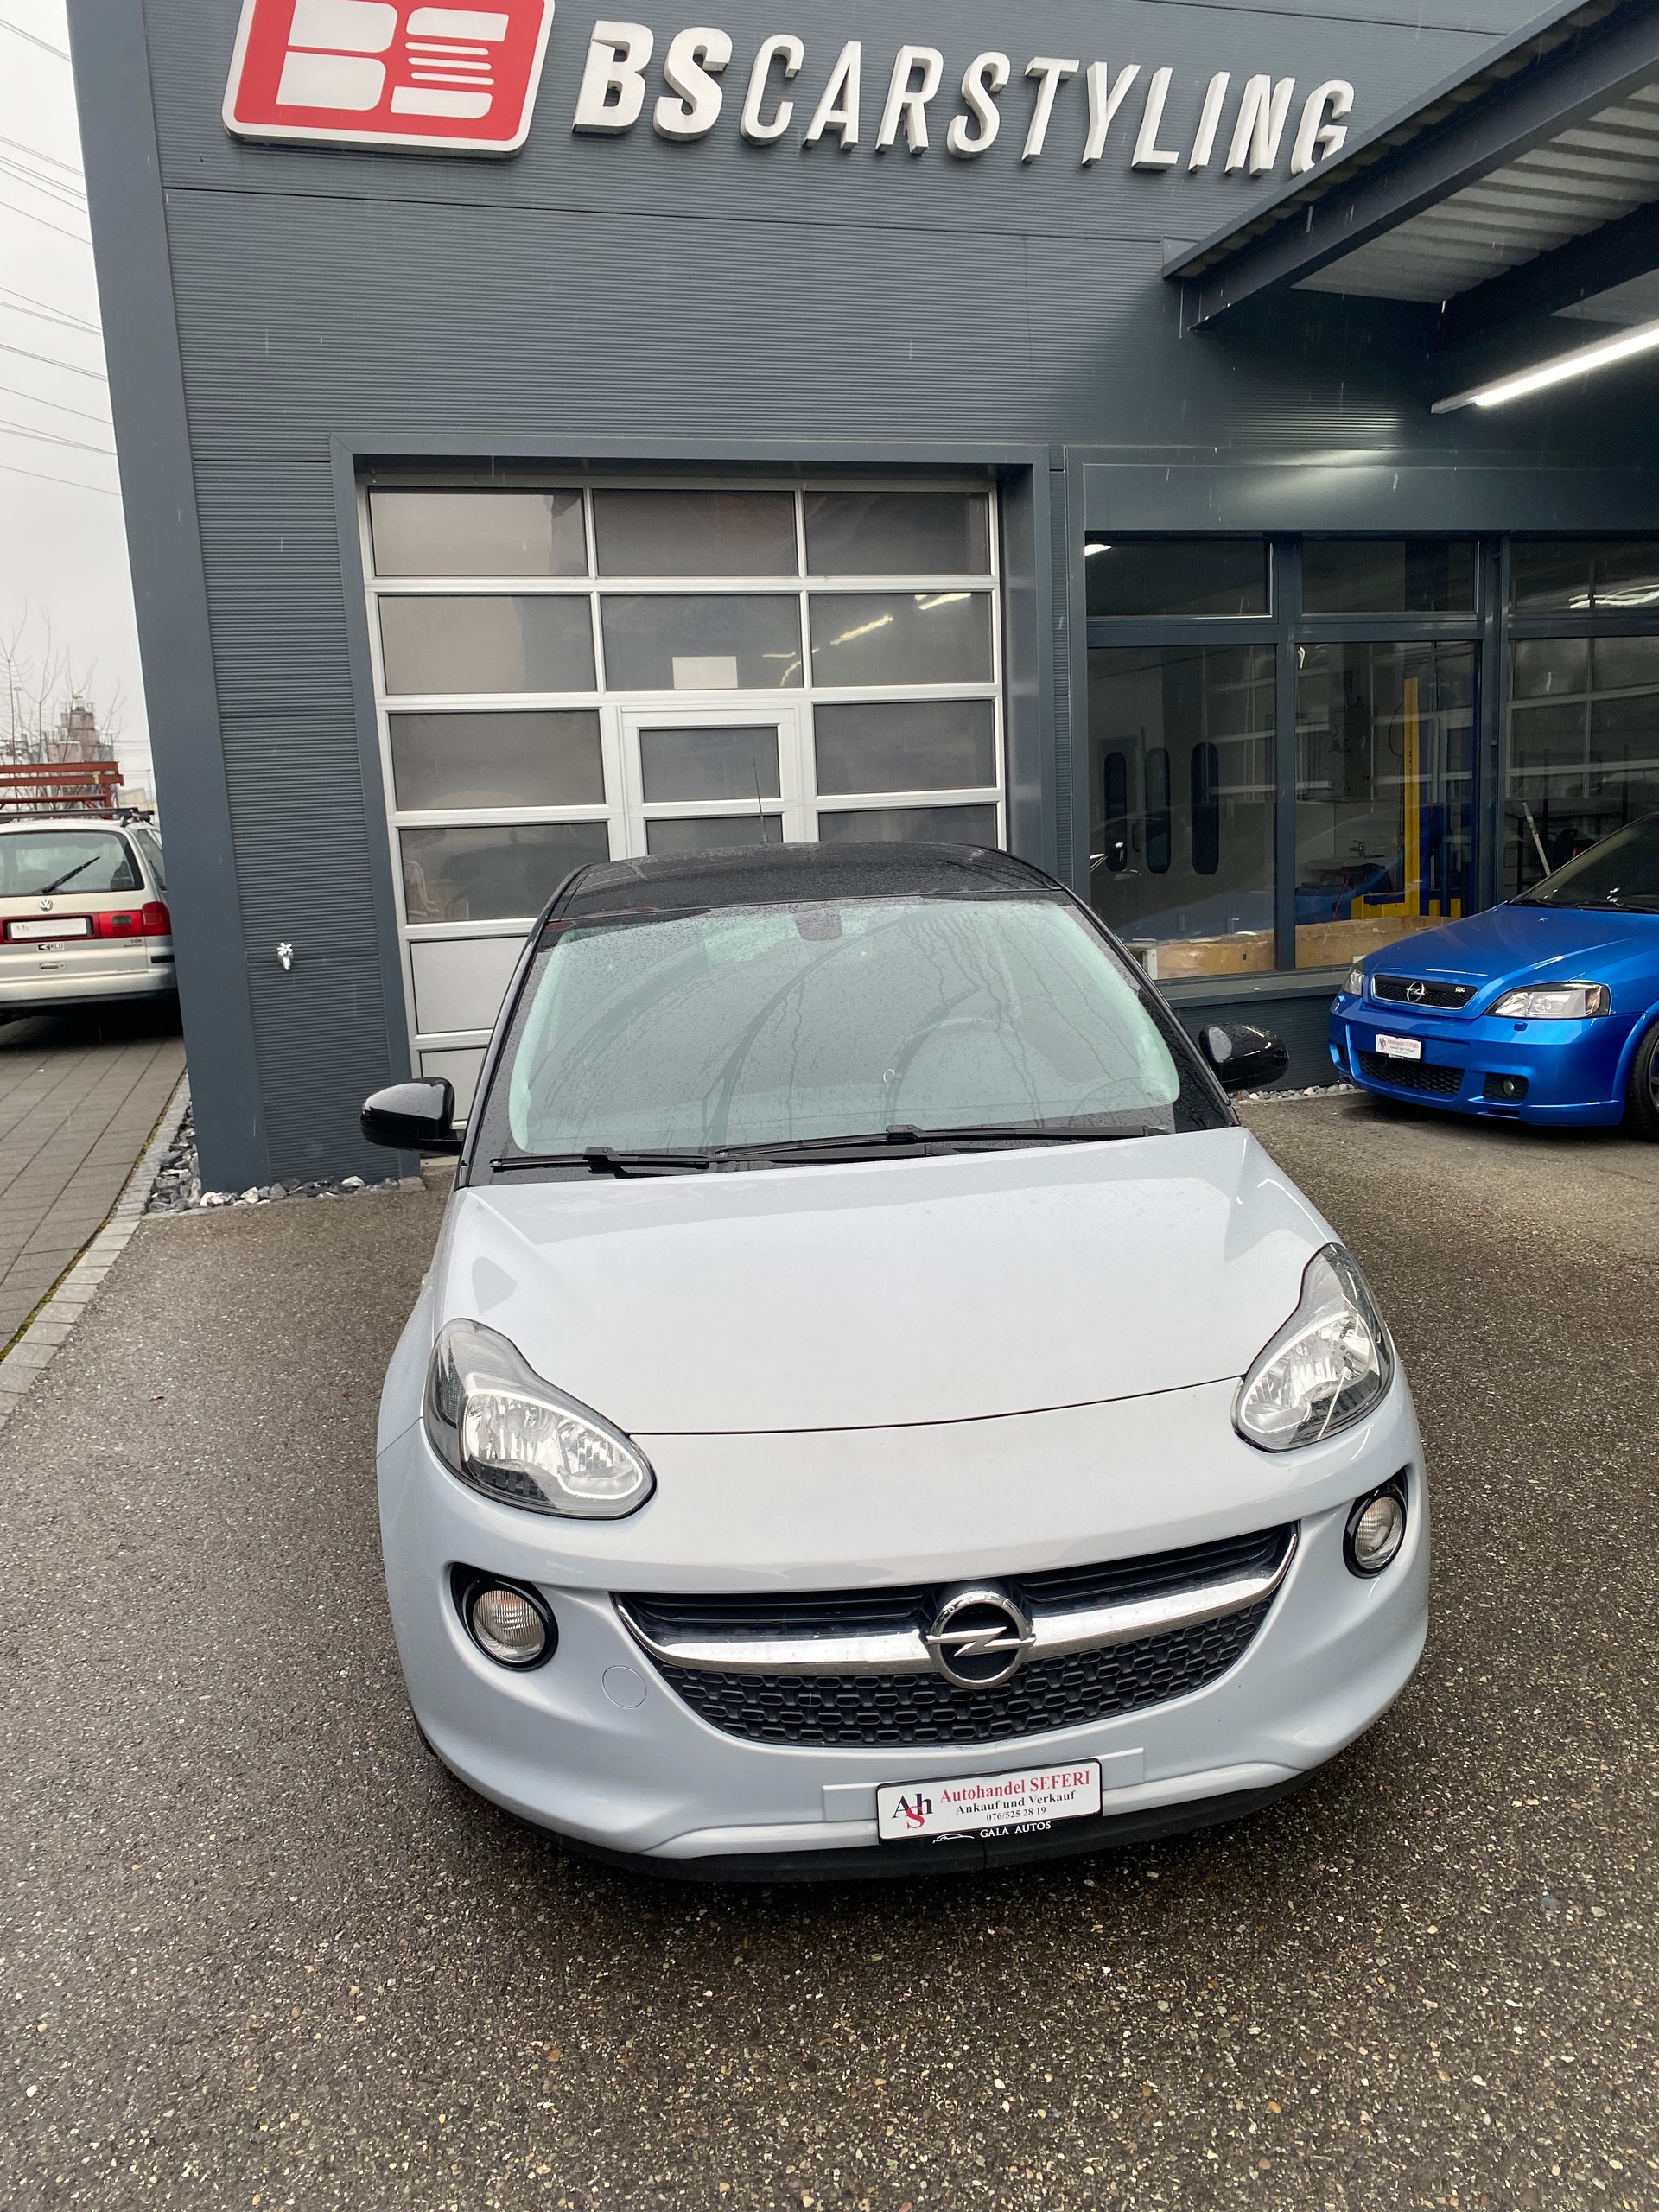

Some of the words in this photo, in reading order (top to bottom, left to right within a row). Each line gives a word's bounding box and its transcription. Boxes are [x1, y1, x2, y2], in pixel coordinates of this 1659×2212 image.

[940, 1779, 1026, 1804] Autohandel
[1030, 1770, 1090, 1792] SEFERI
[956, 1800, 1001, 1815] Ankauf
[1003, 1797, 1026, 1808] und
[1028, 1790, 1076, 1805] Verkauf
[1037, 1806, 1046, 1815] 19
[980, 1827, 1010, 1838] GALA
[1014, 1821, 1052, 1834] AUTOS
